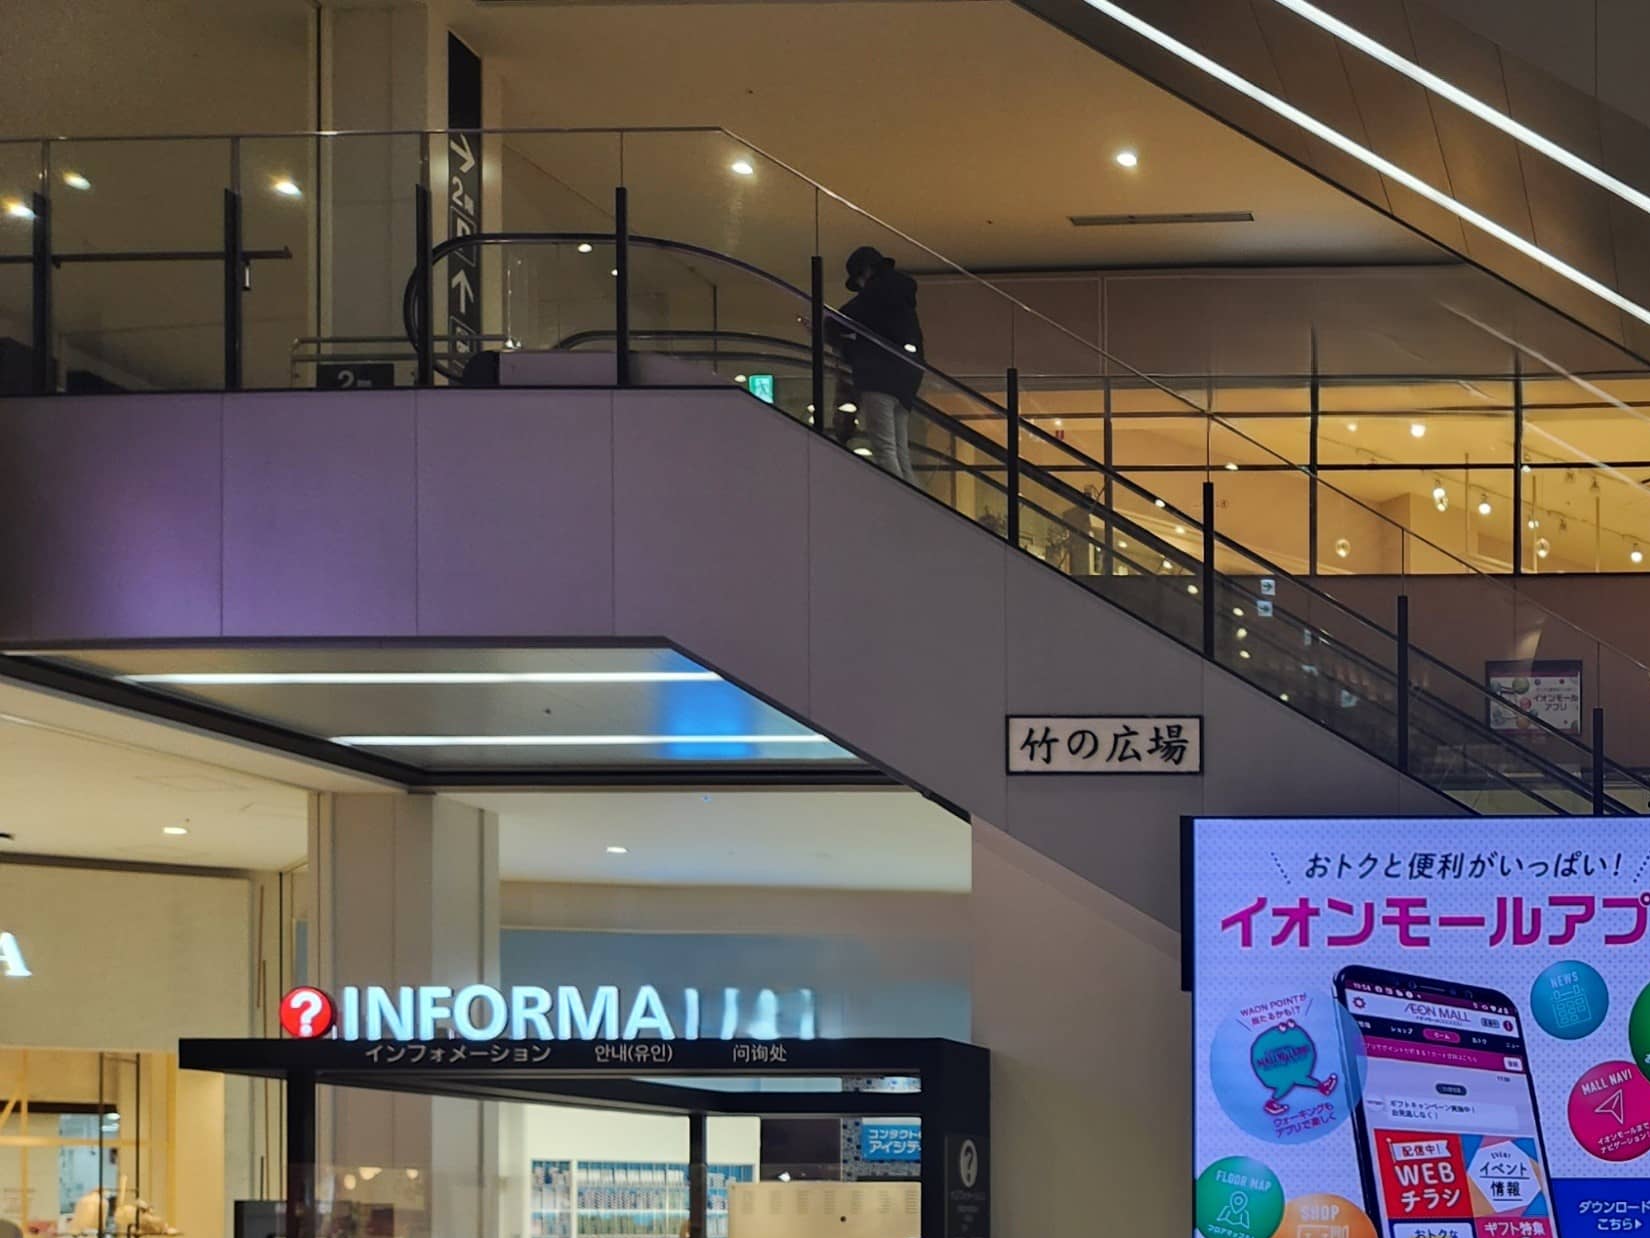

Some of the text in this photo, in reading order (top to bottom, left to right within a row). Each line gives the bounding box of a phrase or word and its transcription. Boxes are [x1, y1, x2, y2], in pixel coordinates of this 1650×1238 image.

[1020, 724, 1189, 765] 竹の広場
[1304, 851, 1623, 880] おトクと便利がいっぱい！
[1551, 972, 1579, 988] NEWS
[365, 1046, 551, 1062] インフォメーション
[594, 1045, 673, 1063] 안내(유인)
[732, 1045, 788, 1062] 问询处
[1581, 1068, 1634, 1096] MALL NAVI
[869, 1129, 922, 1139] コンタクト
[1395, 1162, 1455, 1187] WEB
[1479, 1162, 1529, 1177] イベント
[1216, 1170, 1273, 1192] FLOOR MAP
[1490, 1181, 1521, 1198] 情報
[1401, 1188, 1461, 1213] チラシ
[1301, 1205, 1340, 1221] SHOP
[1598, 1218, 1634, 1231] こちら
